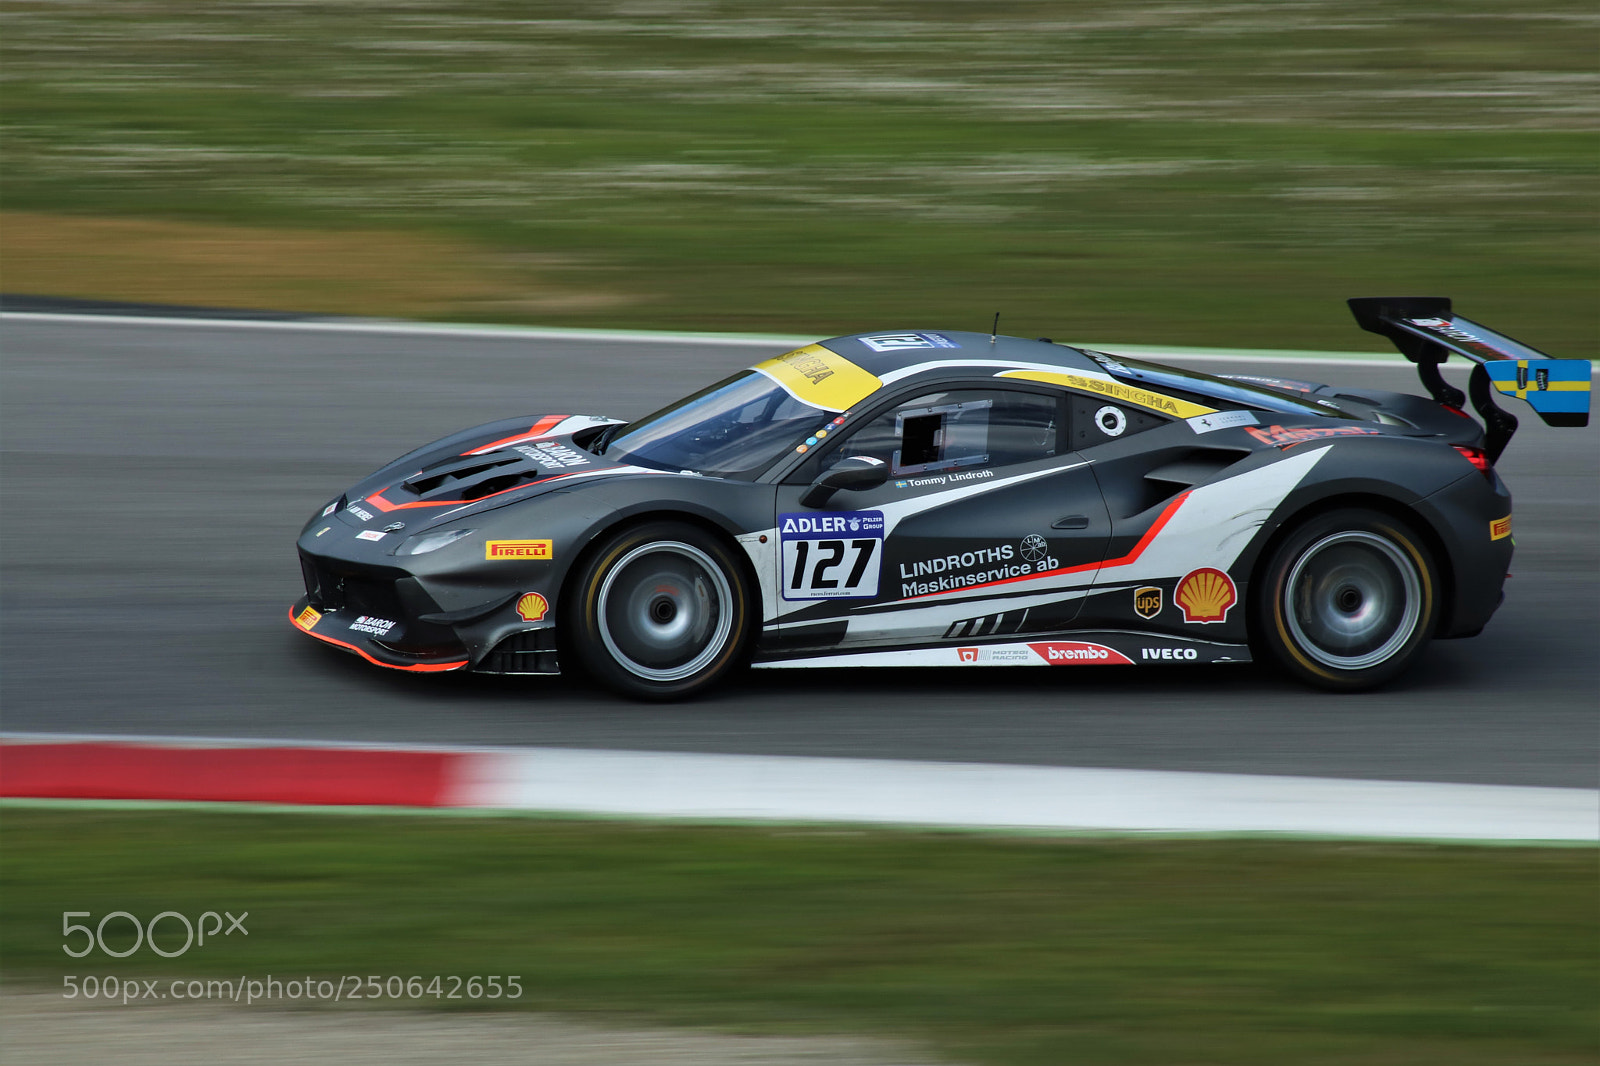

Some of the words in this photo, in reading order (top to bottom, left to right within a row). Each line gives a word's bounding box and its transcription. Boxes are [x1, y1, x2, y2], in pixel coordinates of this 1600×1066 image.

[1089, 380, 1179, 415] SINGHA
[907, 476, 946, 488] Tommy
[949, 469, 994, 482] Lindroth
[782, 517, 846, 533] ADLER
[491, 543, 546, 556] PIRELLI
[791, 539, 876, 589] 127
[900, 544, 1015, 579] LINDROTHS
[901, 564, 1032, 598] Maskinservice
[1036, 556, 1059, 573] ab
[1138, 596, 1160, 611] ups
[348, 622, 389, 636] MOTORSPORT
[363, 616, 397, 630] BARON
[1048, 646, 1109, 660] brembo
[1141, 648, 1198, 660] IVECO
